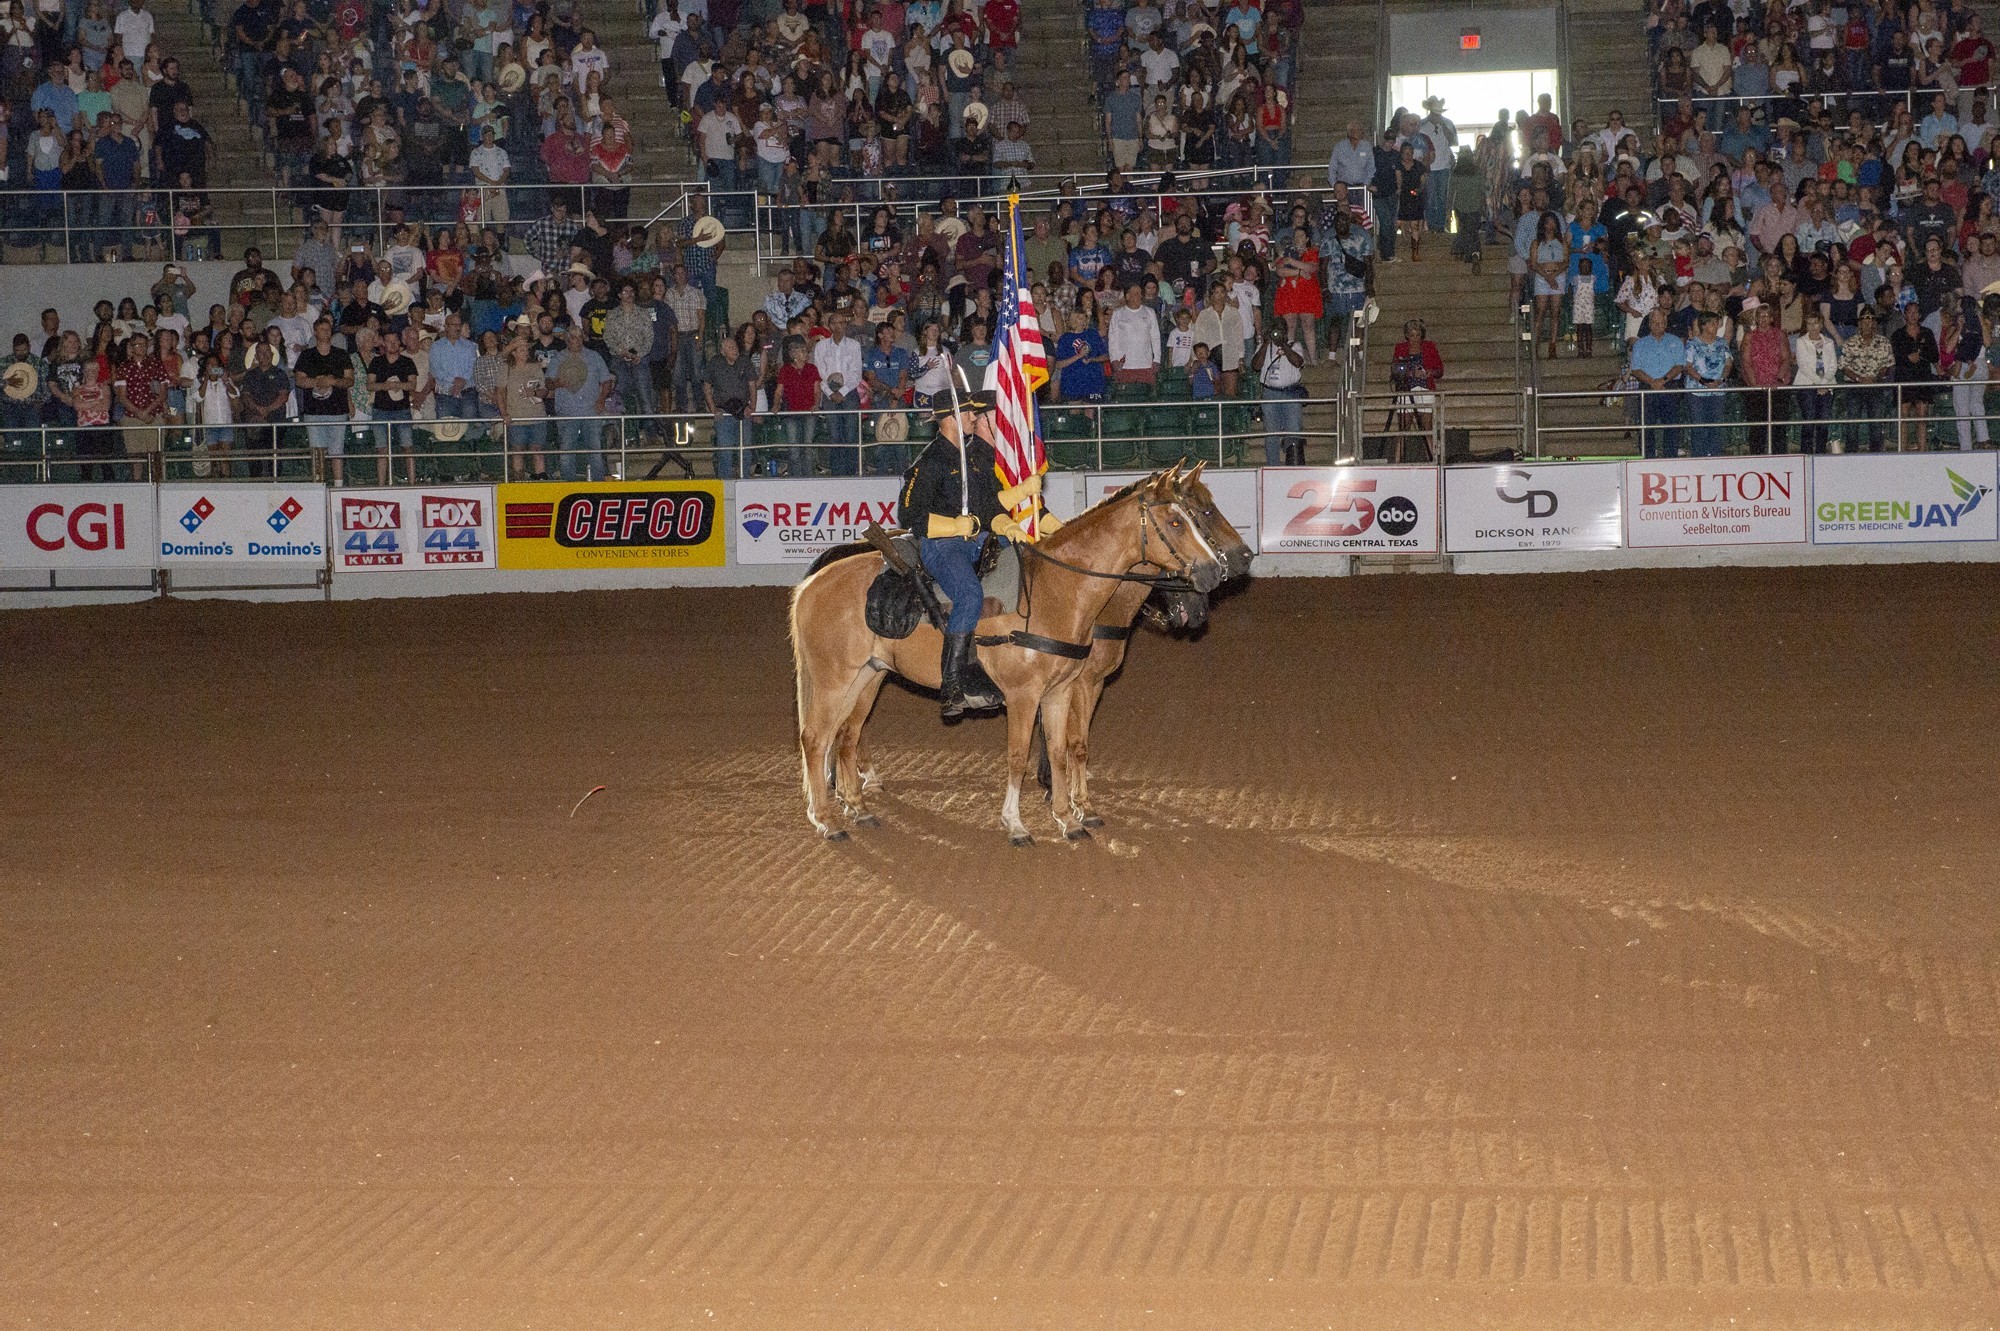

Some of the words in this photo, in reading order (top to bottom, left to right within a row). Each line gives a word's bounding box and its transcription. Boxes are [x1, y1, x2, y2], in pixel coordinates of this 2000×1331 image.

[1639, 471, 1793, 506] BELTON
[425, 502, 478, 527] FOX
[773, 501, 897, 526] RE/MAX
[1281, 479, 1378, 536] 25
[1379, 507, 1416, 522] abc
[1639, 507, 1698, 521] Convention
[1701, 507, 1710, 519] &
[1712, 506, 1750, 519] Visitors
[1753, 505, 1791, 517] Bureau
[345, 504, 397, 528] FOX
[566, 497, 704, 541] CEFCO
[26, 502, 125, 551] CGI
[1475, 528, 1534, 538] DICKSON
[1682, 523, 1750, 535] SeeBelton.com
[1819, 523, 1855, 531] SPORTS
[1859, 523, 1903, 531] MEDICINE
[345, 531, 399, 553] 44
[424, 528, 480, 551] 44
[779, 529, 838, 541] GREAT
[161, 541, 233, 556] Domino's
[248, 541, 322, 556] Domino's
[1279, 539, 1340, 548] CONNECTING
[1342, 539, 1386, 547] CENTRAL
[1388, 539, 1418, 547] TEXAS
[576, 549, 649, 559] CONVENIENCE
[651, 548, 689, 558] STORES
